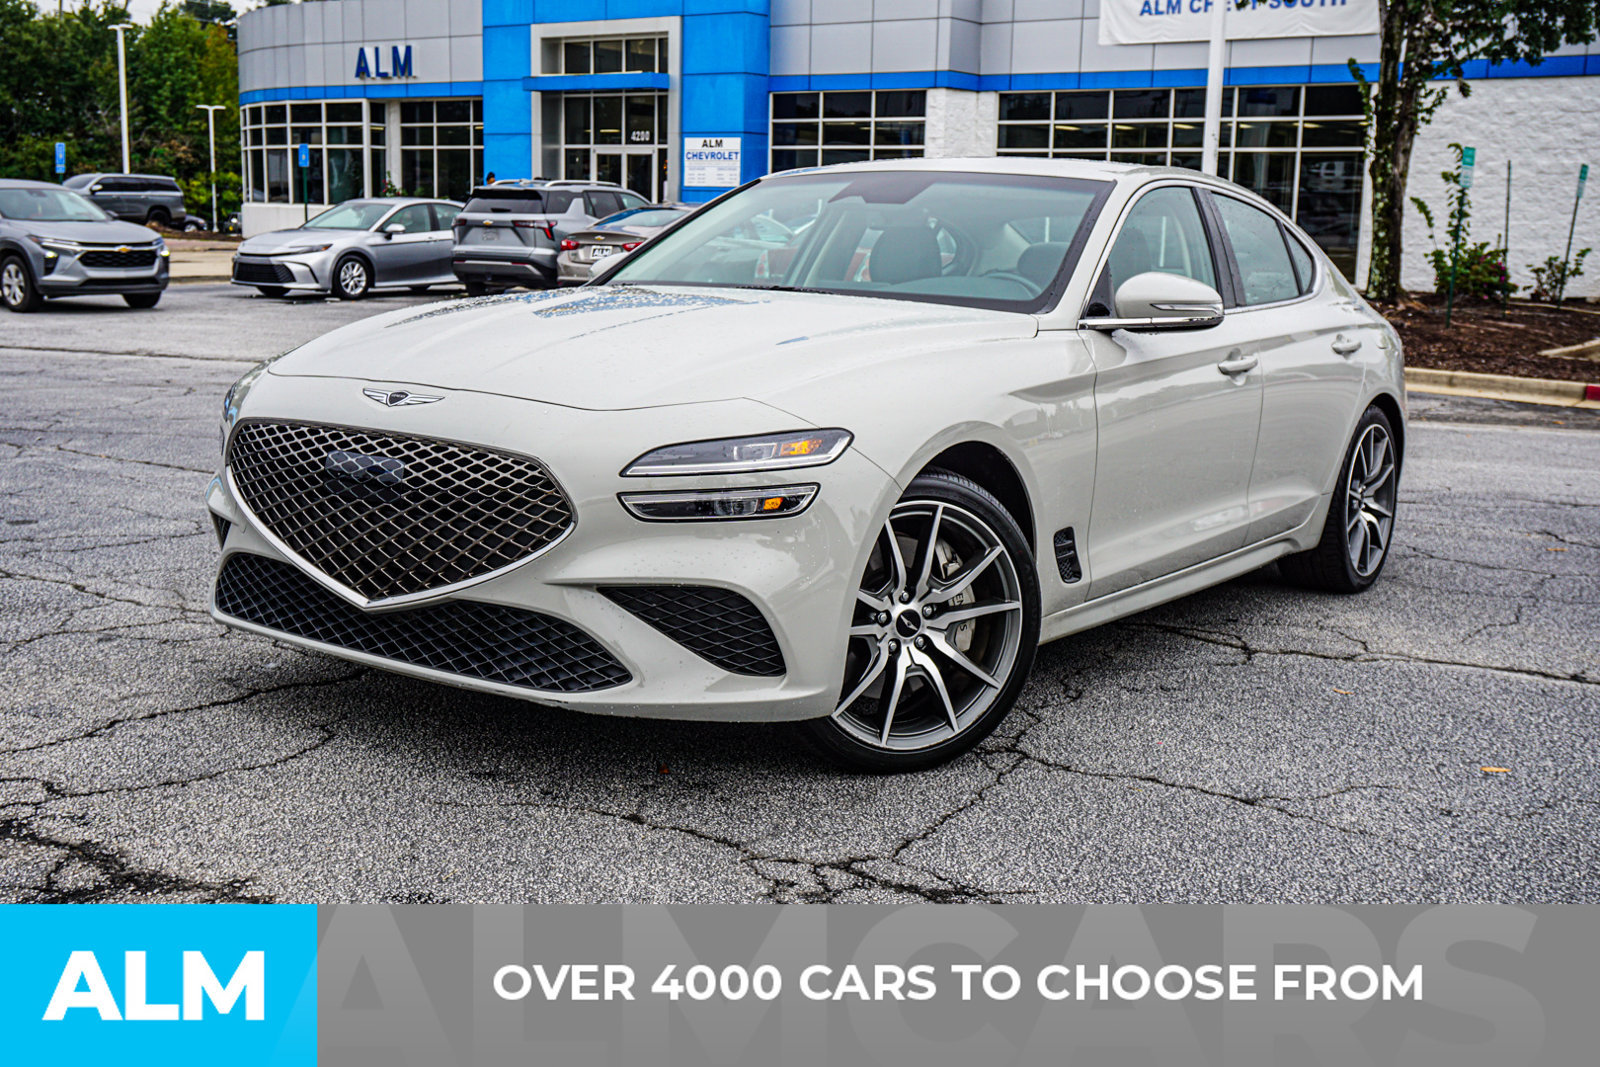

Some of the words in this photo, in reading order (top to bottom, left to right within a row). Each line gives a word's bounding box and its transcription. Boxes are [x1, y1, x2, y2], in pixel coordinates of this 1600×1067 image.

[1139, 0, 1182, 16] ALM
[355, 45, 412, 78] ALM
[631, 130, 650, 141] 4200
[701, 139, 723, 148] ALM
[686, 151, 740, 160] CHEVROLET
